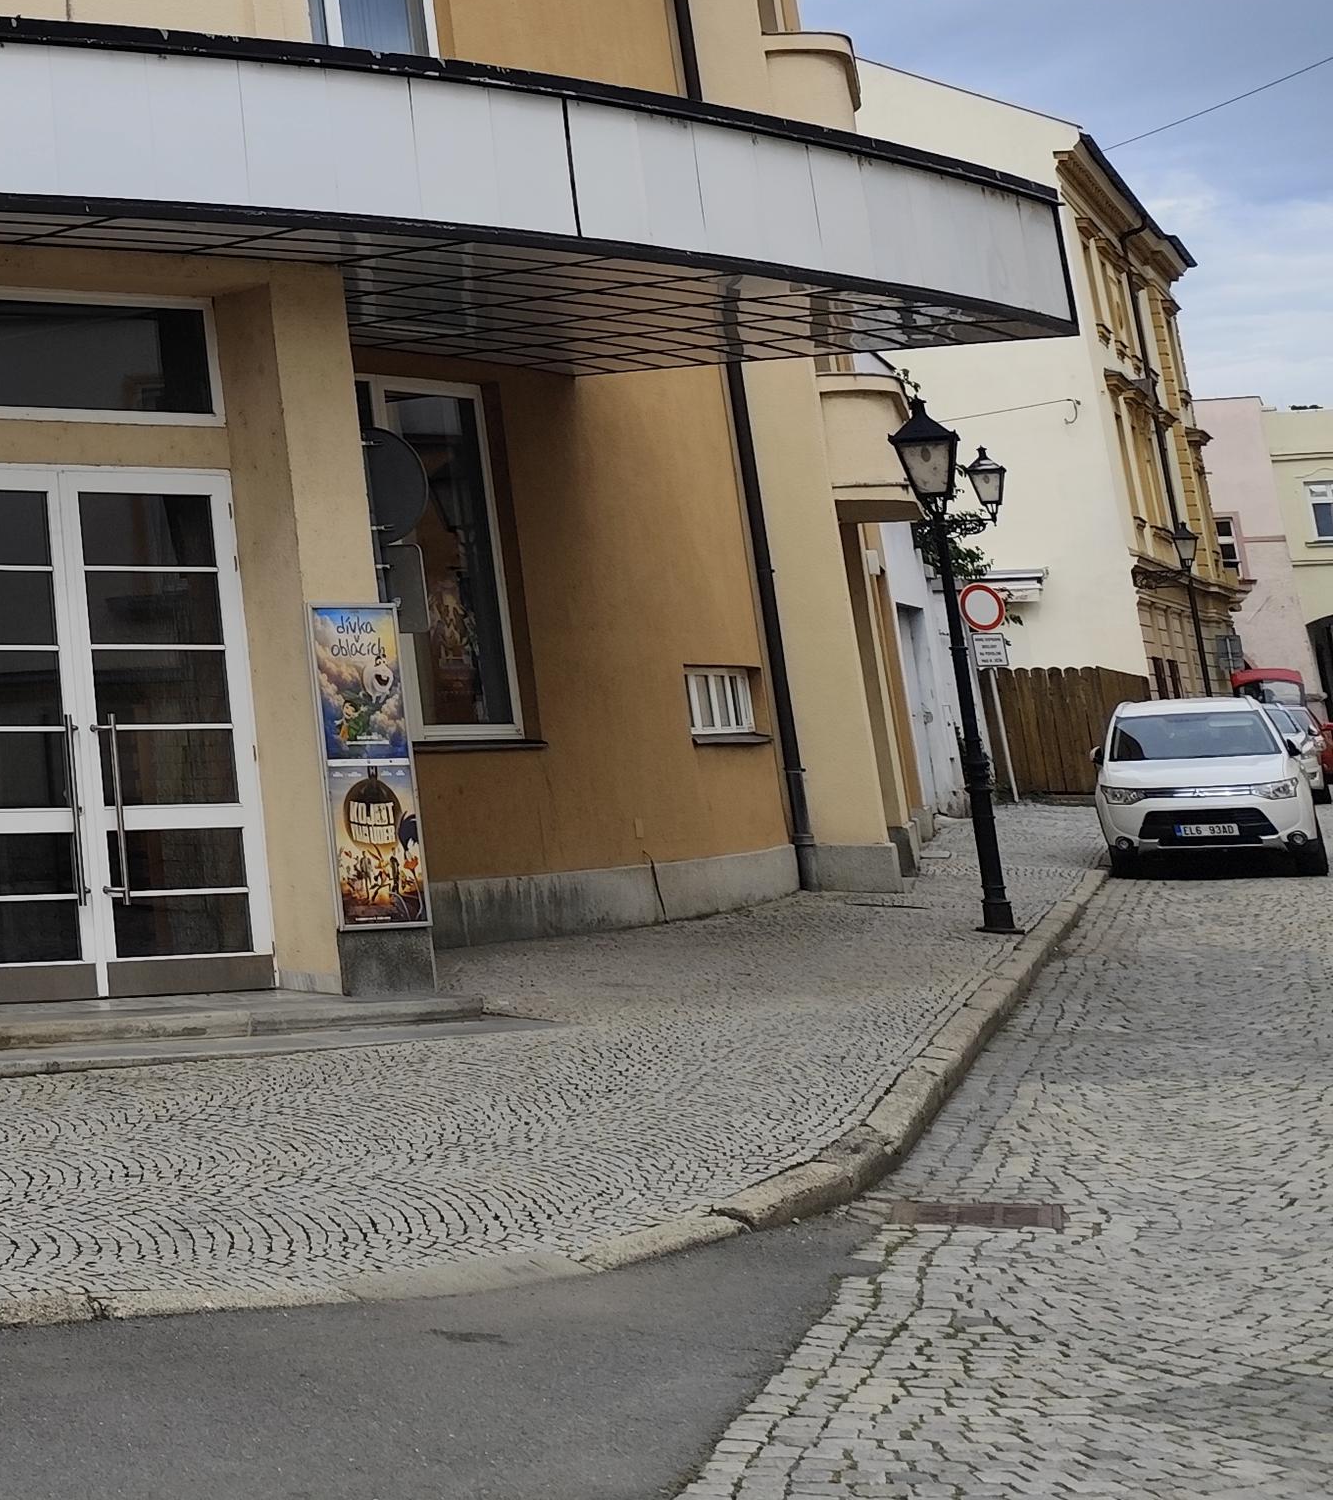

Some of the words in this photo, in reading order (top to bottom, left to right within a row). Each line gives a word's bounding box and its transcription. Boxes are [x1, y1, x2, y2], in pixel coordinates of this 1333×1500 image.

[336, 615, 376, 634] dívka
[353, 635, 360, 643] v
[330, 637, 386, 658] oblacích
[1208, 825, 1235, 835] 93AD
